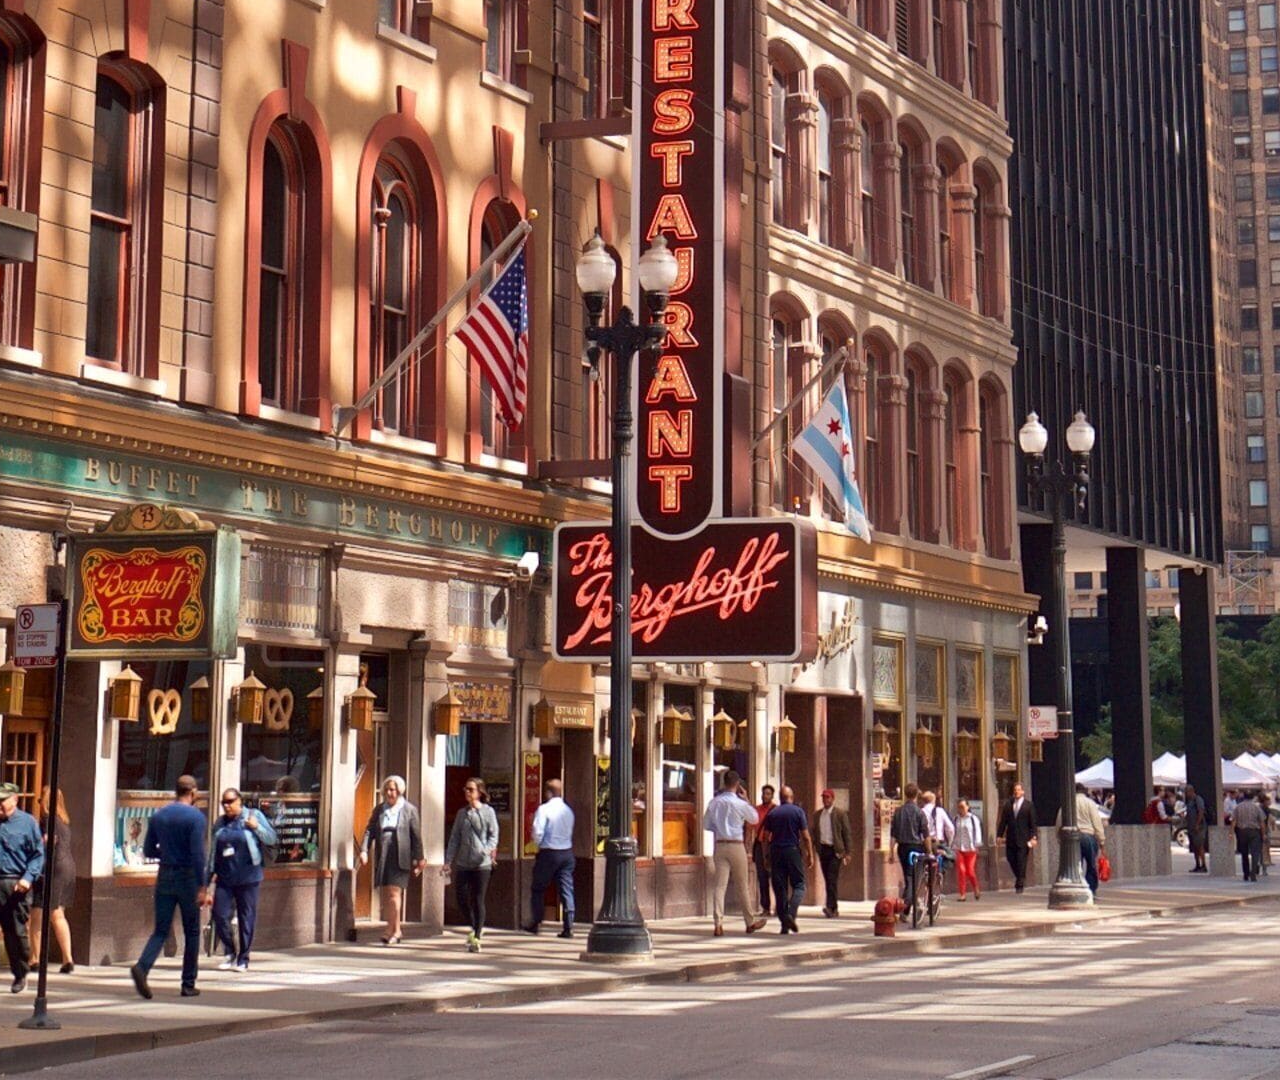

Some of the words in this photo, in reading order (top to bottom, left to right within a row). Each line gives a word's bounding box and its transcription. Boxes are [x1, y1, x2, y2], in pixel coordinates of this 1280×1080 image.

[85, 456, 200, 497] BUFFET
[239, 477, 309, 517] THE
[338, 495, 500, 549] BERGHOFF
[96, 562, 193, 606] Berghoff
[563, 532, 790, 650] Brghoff
[111, 607, 173, 627] BAR
[554, 705, 588, 716] ESTAURANT
